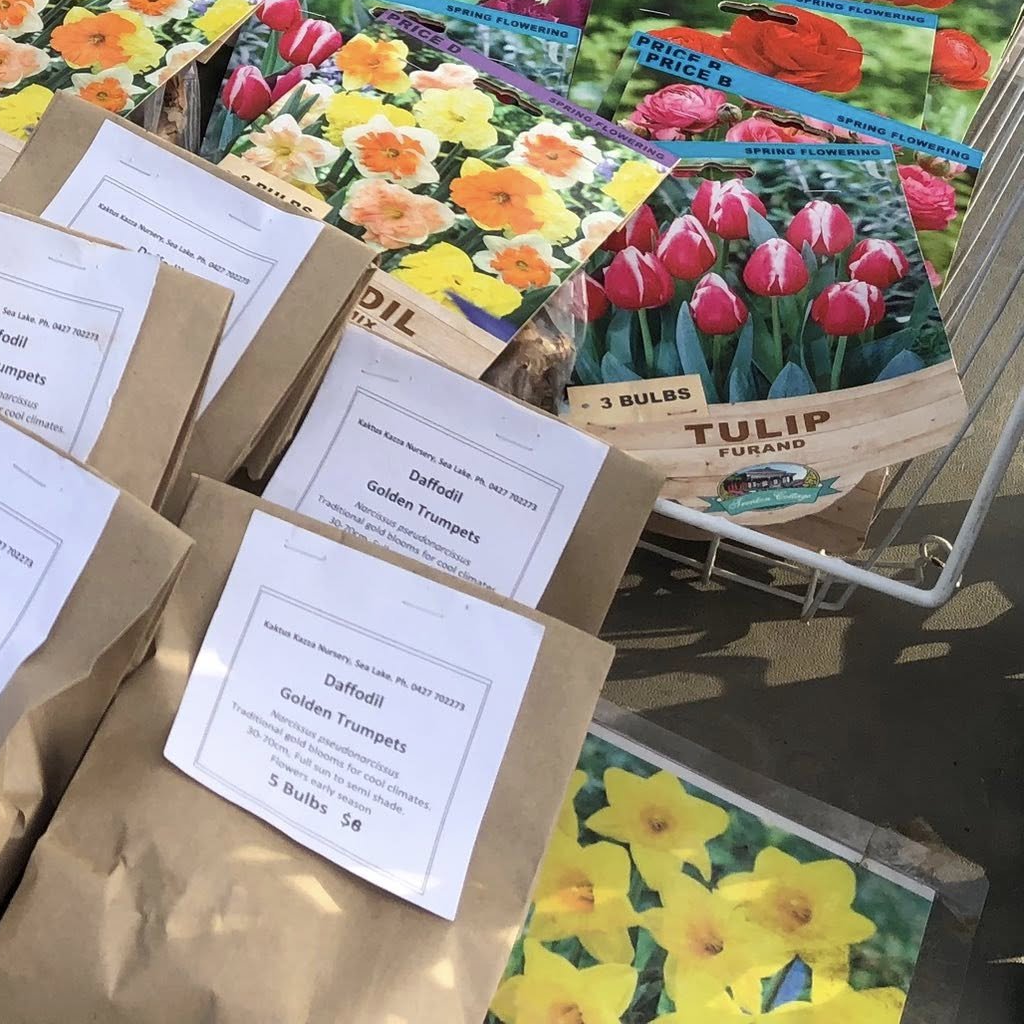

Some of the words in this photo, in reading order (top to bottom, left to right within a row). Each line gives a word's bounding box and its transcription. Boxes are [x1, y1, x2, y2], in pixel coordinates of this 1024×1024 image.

[848, 4, 926, 24] FLOWERING
[836, 114, 888, 137] SPRING
[891, 130, 970, 160] FLOWERING
[600, 396, 612, 410] 3
[620, 388, 692, 408] BULBS
[684, 410, 832, 445] TULIP
[719, 438, 806, 458] FURAND
[366, 480, 414, 512] Golden
[417, 504, 480, 545] Trumpets
[408, 469, 464, 504] Daffodil
[7, 544, 34, 568] 702273
[264, 620, 292, 638] Kaktus
[293, 634, 316, 650] Kazza
[318, 643, 352, 666] Nursery,
[355, 659, 370, 672] Sea
[395, 676, 409, 688] Ph.
[410, 682, 432, 698] 0427
[434, 692, 466, 712] 702273
[324, 672, 385, 710] Daffodil
[270, 710, 317, 739] Narcissus
[318, 736, 400, 780] pseudonarcissus
[280, 686, 332, 720] Golden
[337, 712, 408, 754] Trumpets
[232, 701, 284, 736] Traditional
[284, 732, 306, 748] gold
[308, 742, 346, 768] blooms
[347, 760, 362, 774] for
[364, 770, 386, 788] cool
[387, 782, 432, 812] climates.
[268, 773, 278, 787] 5
[282, 780, 328, 815] Bulbs
[340, 812, 362, 833] $8
[270, 754, 308, 782] Flowers
[310, 776, 336, 796] early
[337, 790, 372, 816] season
[294, 751, 312, 768] Full
[314, 766, 332, 779] sun
[333, 772, 344, 784] to
[347, 780, 370, 798] semi
[372, 790, 405, 816] shade.
